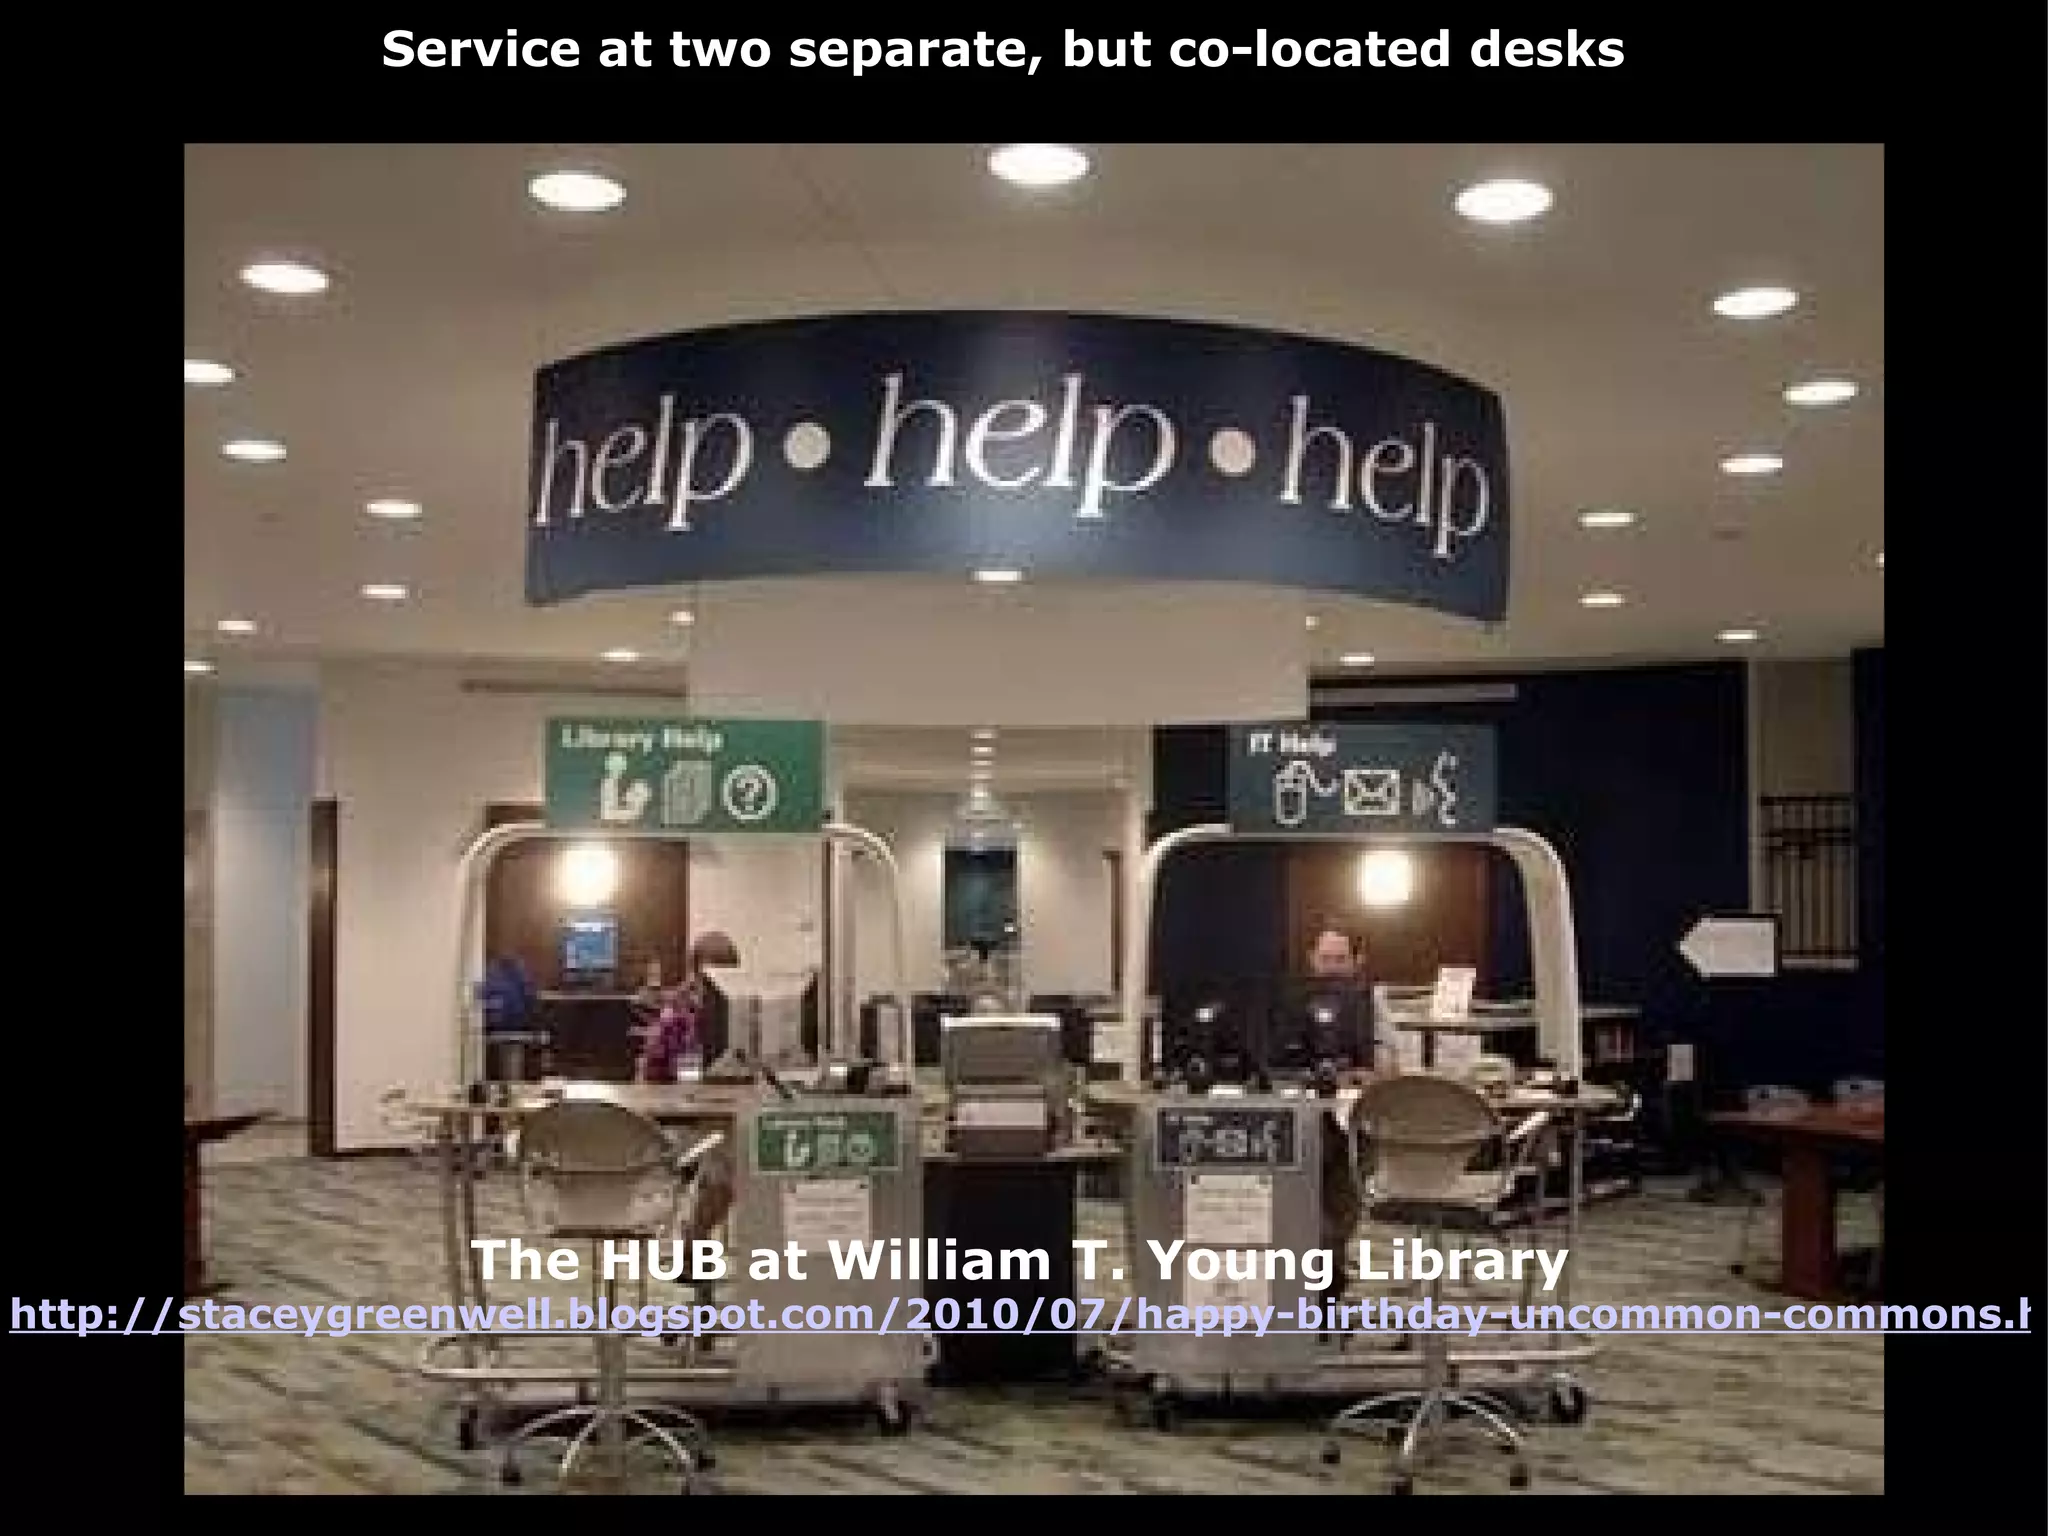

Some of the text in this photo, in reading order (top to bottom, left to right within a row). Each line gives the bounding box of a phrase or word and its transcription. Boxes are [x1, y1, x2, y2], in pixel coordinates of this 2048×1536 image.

[535, 372, 1490, 558] help help help
[1248, 732, 1275, 753] IT
